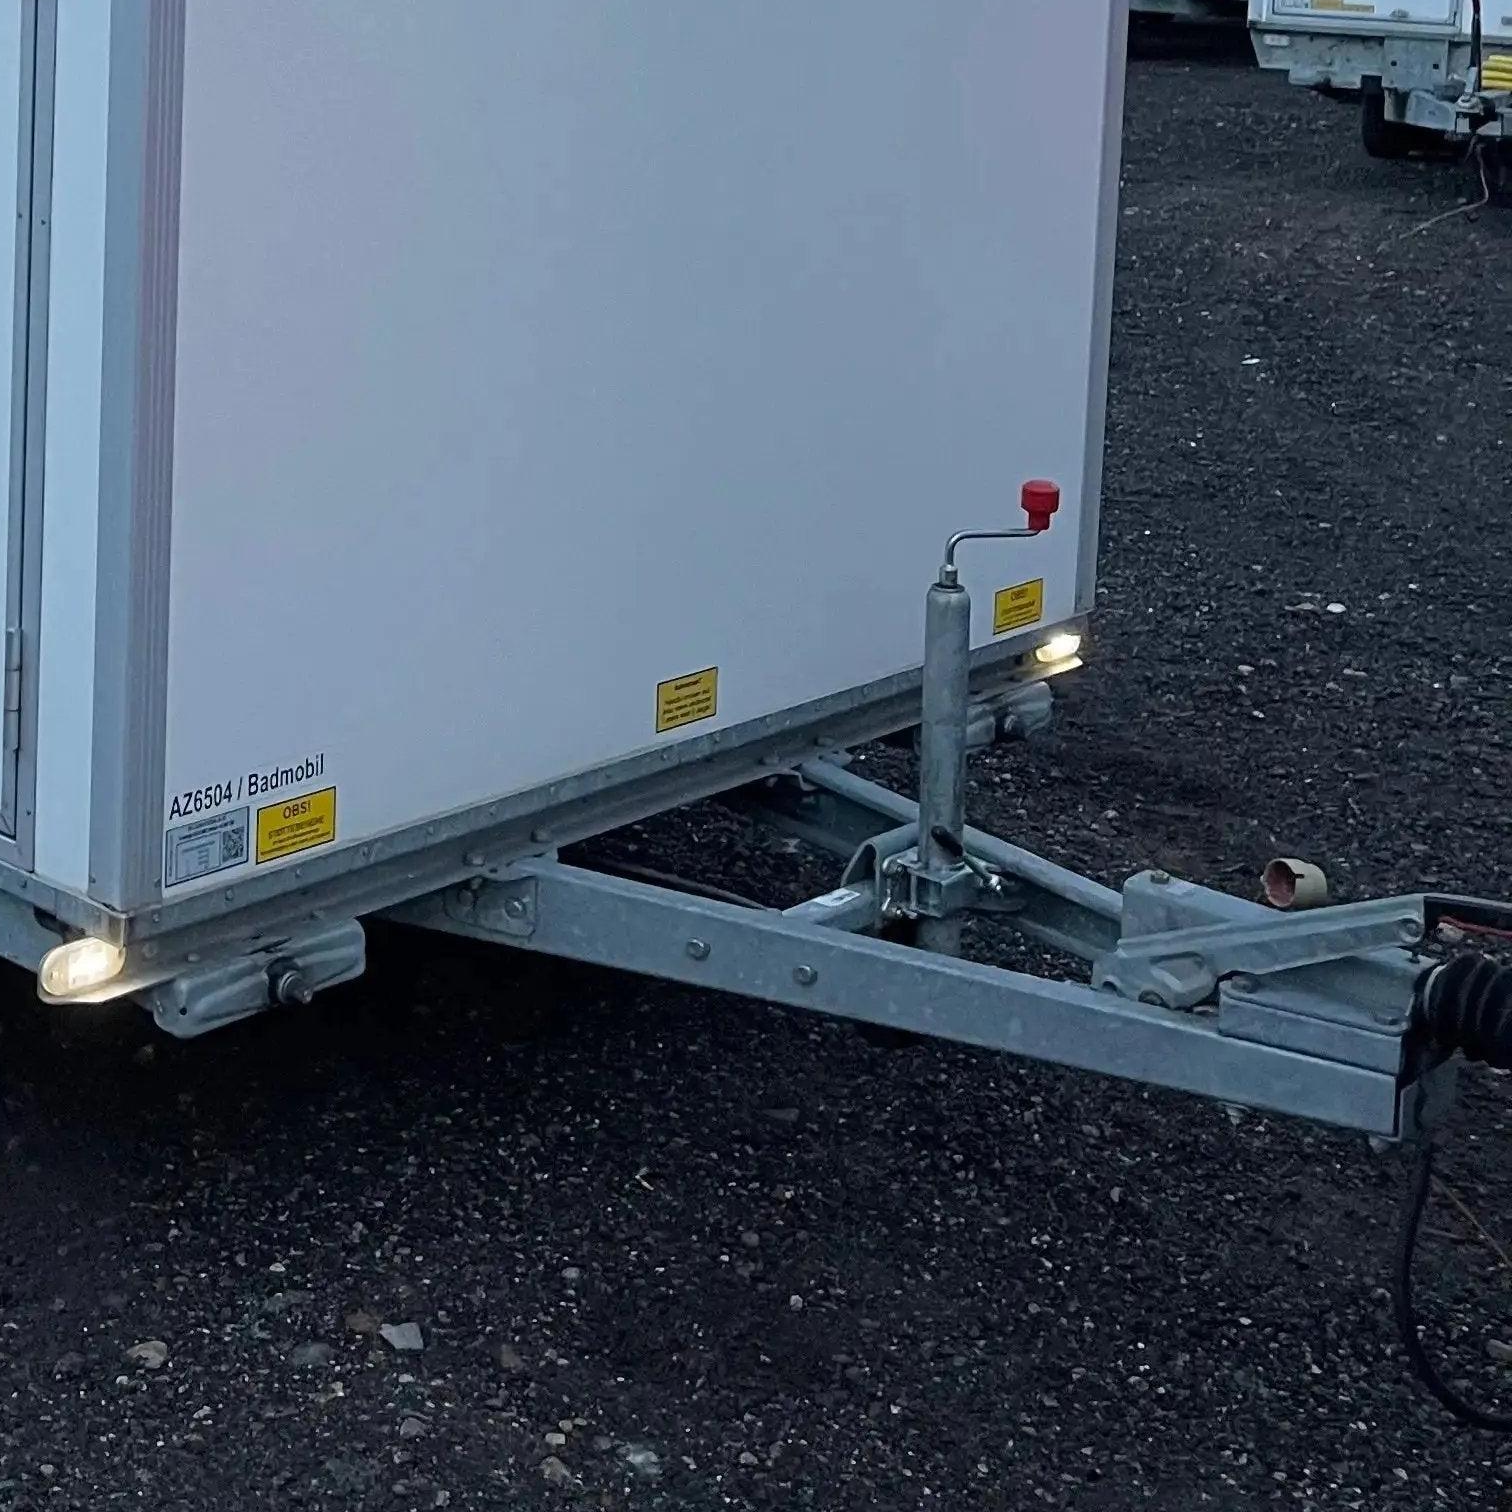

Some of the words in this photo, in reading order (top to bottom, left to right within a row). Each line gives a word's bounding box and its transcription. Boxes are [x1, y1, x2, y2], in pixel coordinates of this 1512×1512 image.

[169, 780, 232, 820] AZ6504
[237, 777, 243, 800] /
[248, 753, 324, 796] Badmobil
[283, 800, 311, 819] OBS!
